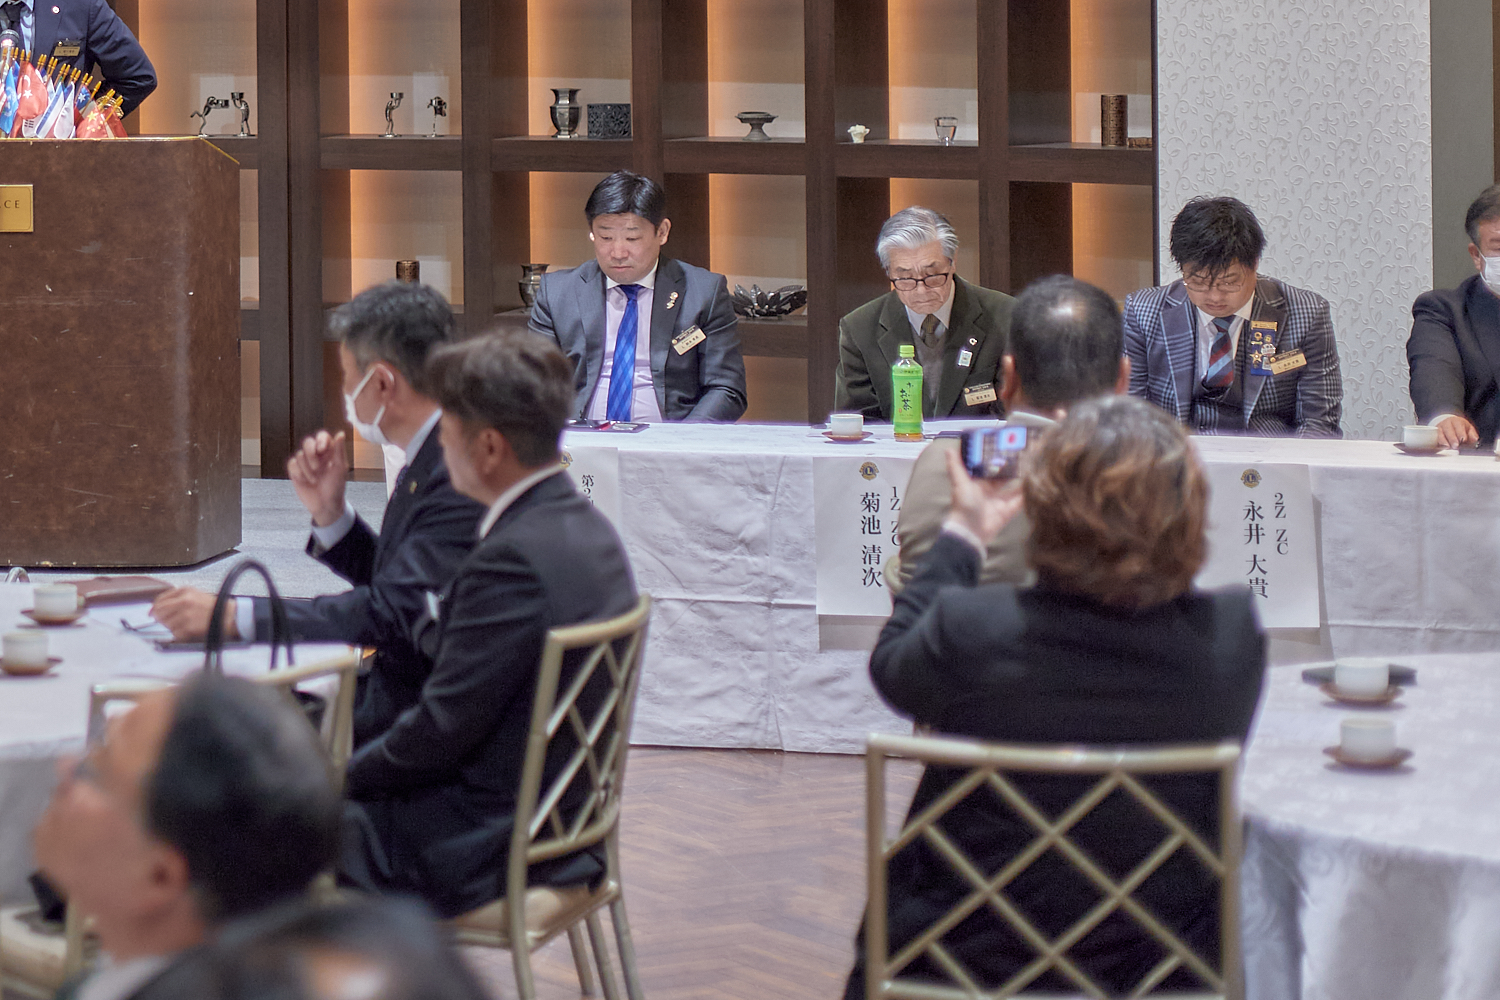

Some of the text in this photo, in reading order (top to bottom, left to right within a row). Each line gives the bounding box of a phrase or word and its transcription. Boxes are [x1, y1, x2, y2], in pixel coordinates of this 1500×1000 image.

[581, 474, 595, 506] 第2
[860, 492, 883, 588] 菊池 清次
[1242, 500, 1266, 545] 永井
